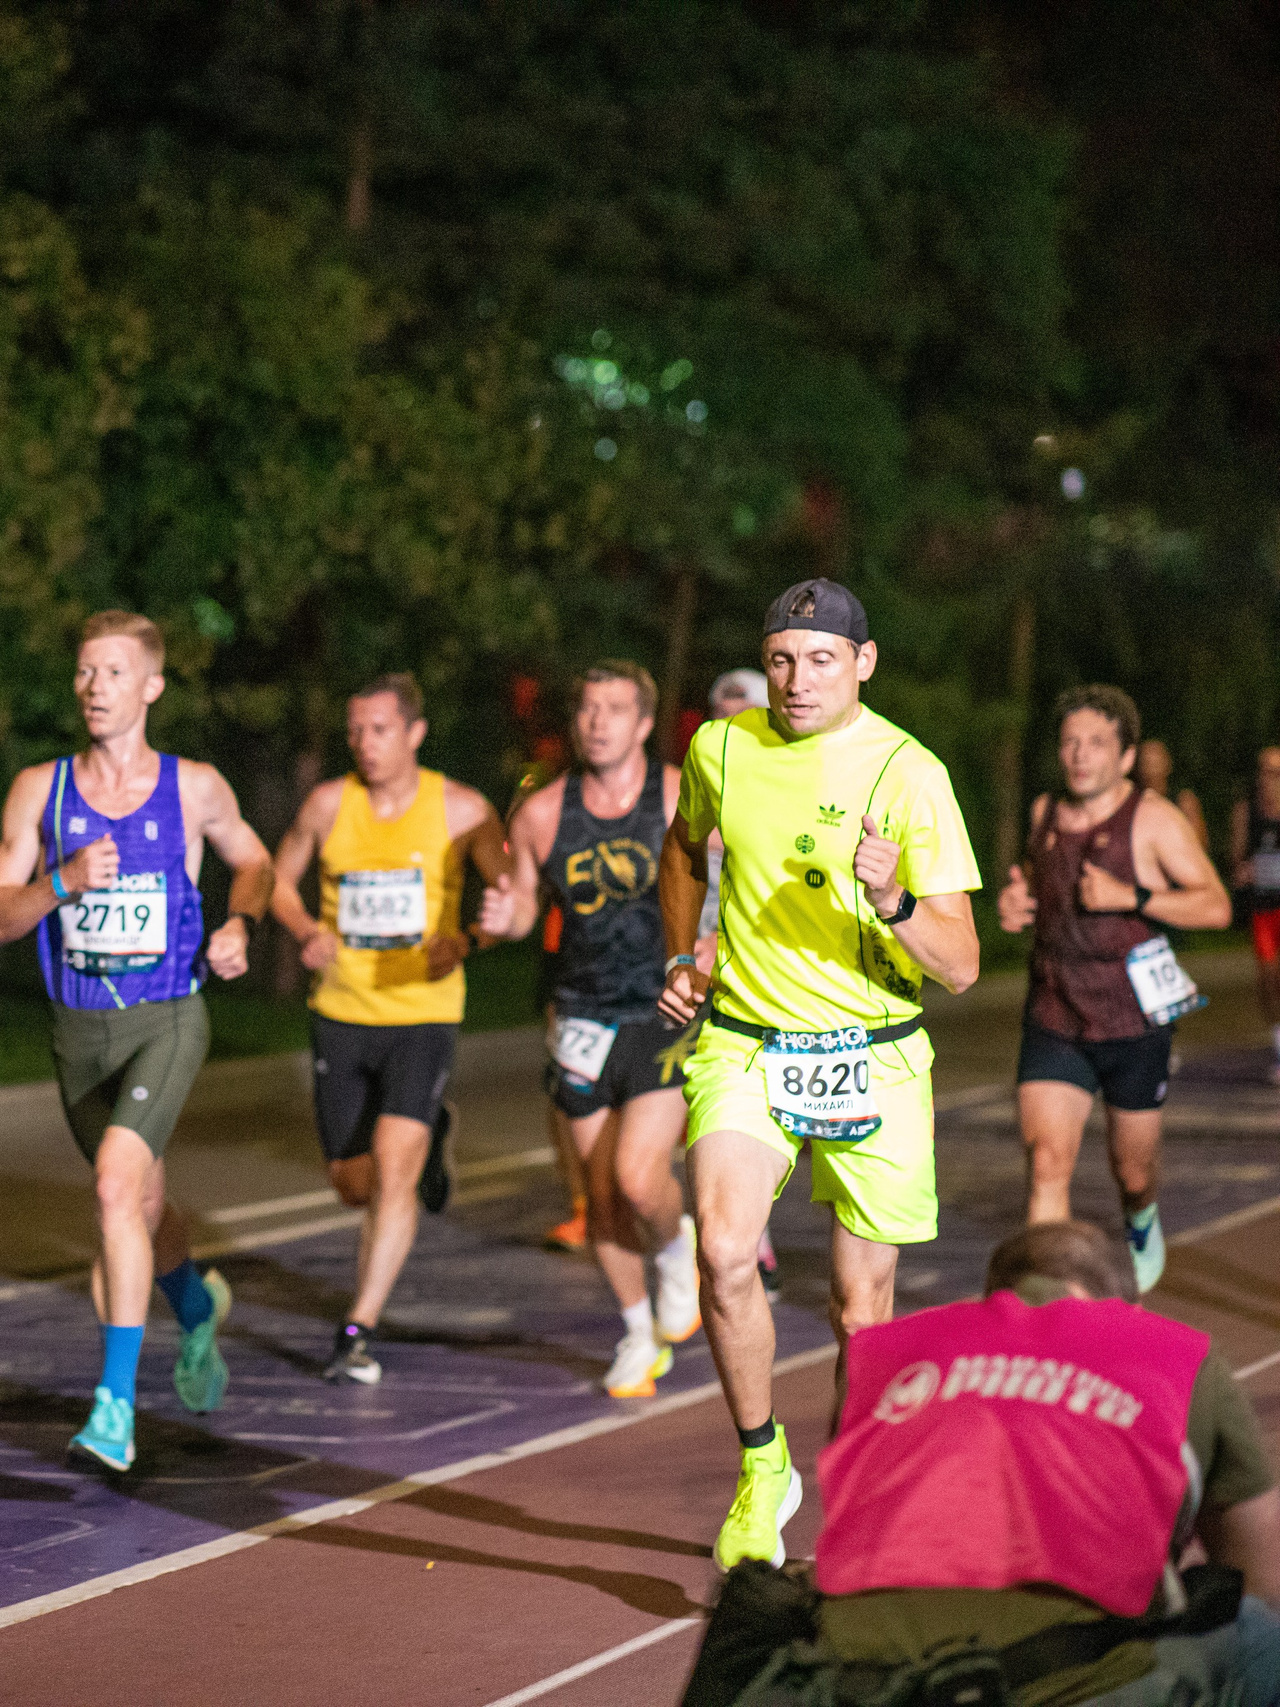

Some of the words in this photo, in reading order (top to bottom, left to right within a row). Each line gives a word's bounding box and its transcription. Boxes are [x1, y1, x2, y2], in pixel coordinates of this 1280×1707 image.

[75, 904, 150, 932] 2719
[782, 1060, 869, 1098] 8620
[803, 1100, 854, 1112] МИХАИЛ
